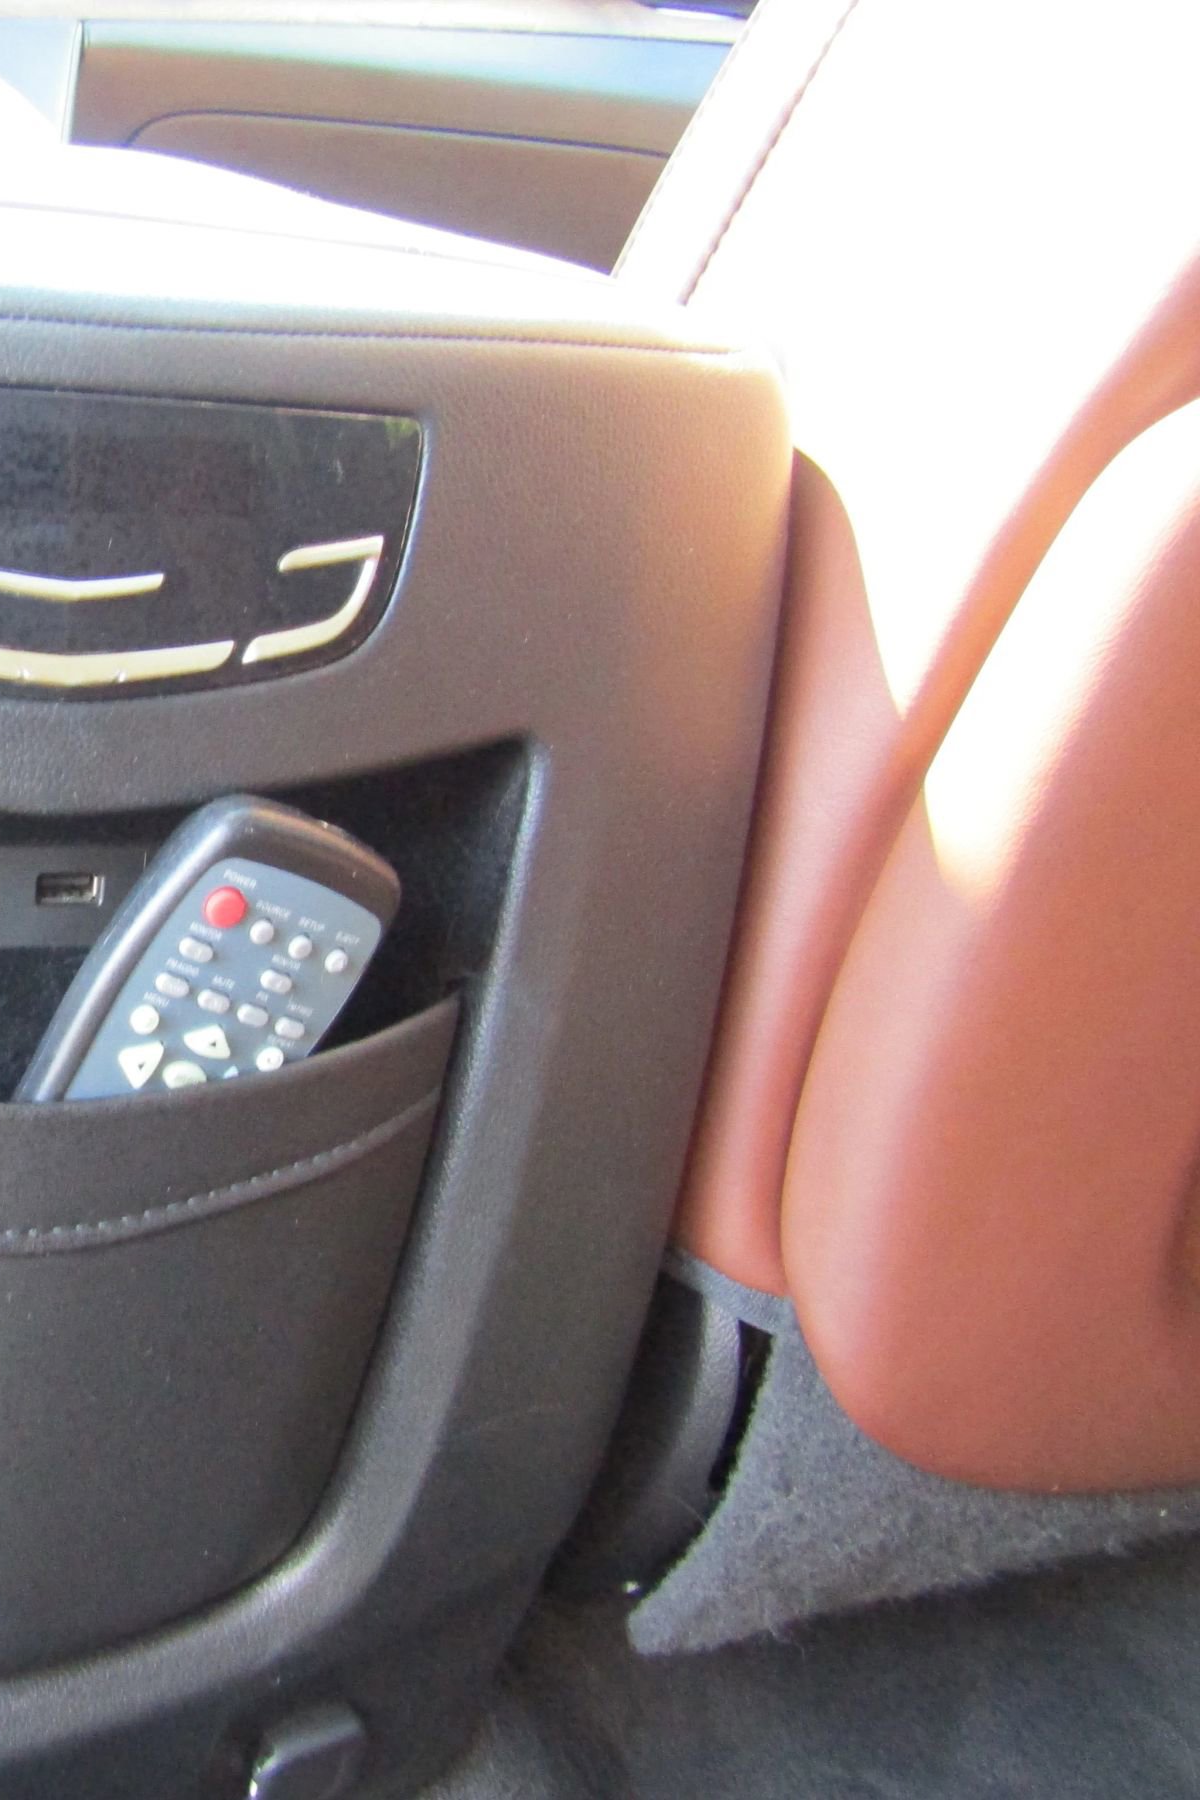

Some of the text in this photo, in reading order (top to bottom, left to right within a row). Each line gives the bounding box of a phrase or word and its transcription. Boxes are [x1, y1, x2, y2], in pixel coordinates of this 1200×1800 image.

[223, 868, 257, 889] POWER
[256, 900, 292, 918] SOURCE
[299, 917, 325, 932] SETUP
[212, 974, 236, 989] MUTE
[143, 992, 170, 1008] MENU
